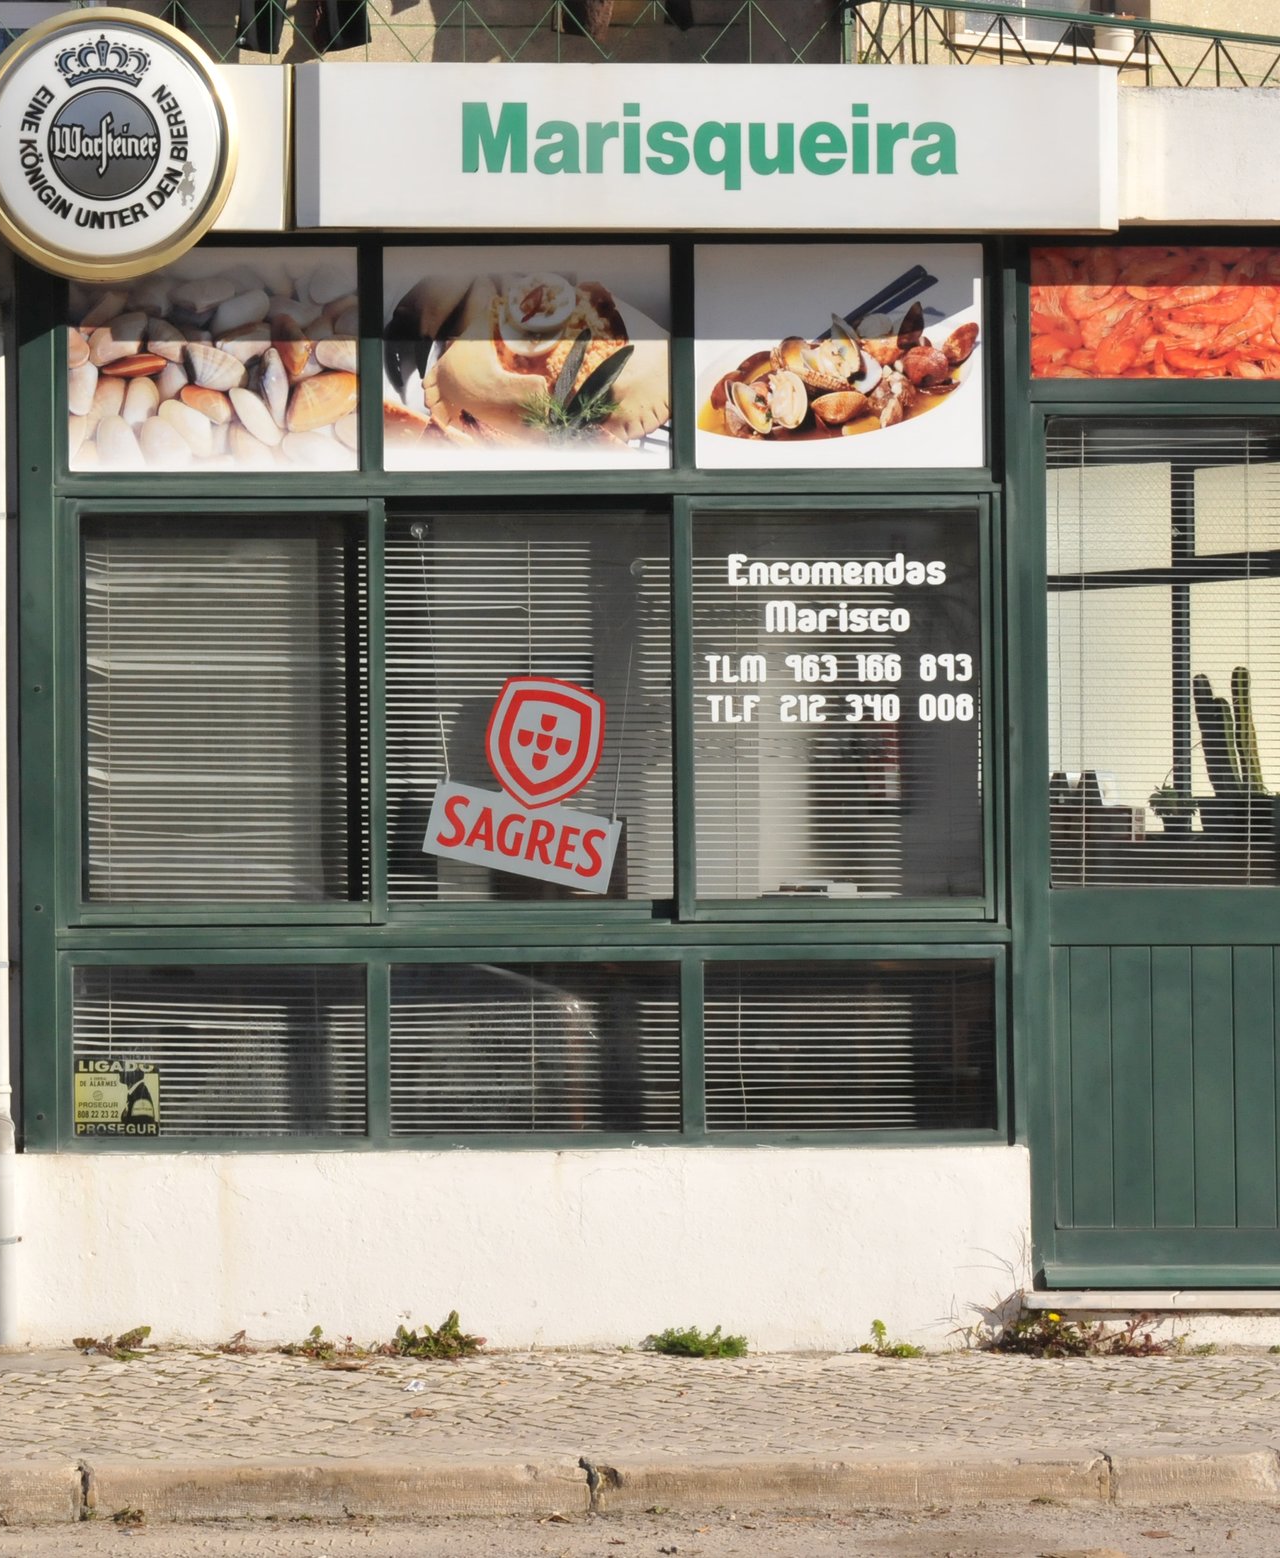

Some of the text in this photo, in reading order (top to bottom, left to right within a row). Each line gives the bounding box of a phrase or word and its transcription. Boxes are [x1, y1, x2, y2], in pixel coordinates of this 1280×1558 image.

[20, 84, 188, 230] EINE KÖNIGIN UNTER DEN BIEREN
[461, 102, 959, 190] Marisqueira
[727, 552, 947, 586] Encomendas
[765, 600, 911, 633] Marisco
[704, 653, 973, 683] TLM 963 166 893
[706, 693, 974, 723] TLF 212 340 008
[436, 795, 608, 878] SAGRES
[78, 1060, 155, 1073] LIGADO
[78, 1101, 119, 1109] PROSEGUR
[76, 1123, 157, 1135] PROSEGUR
